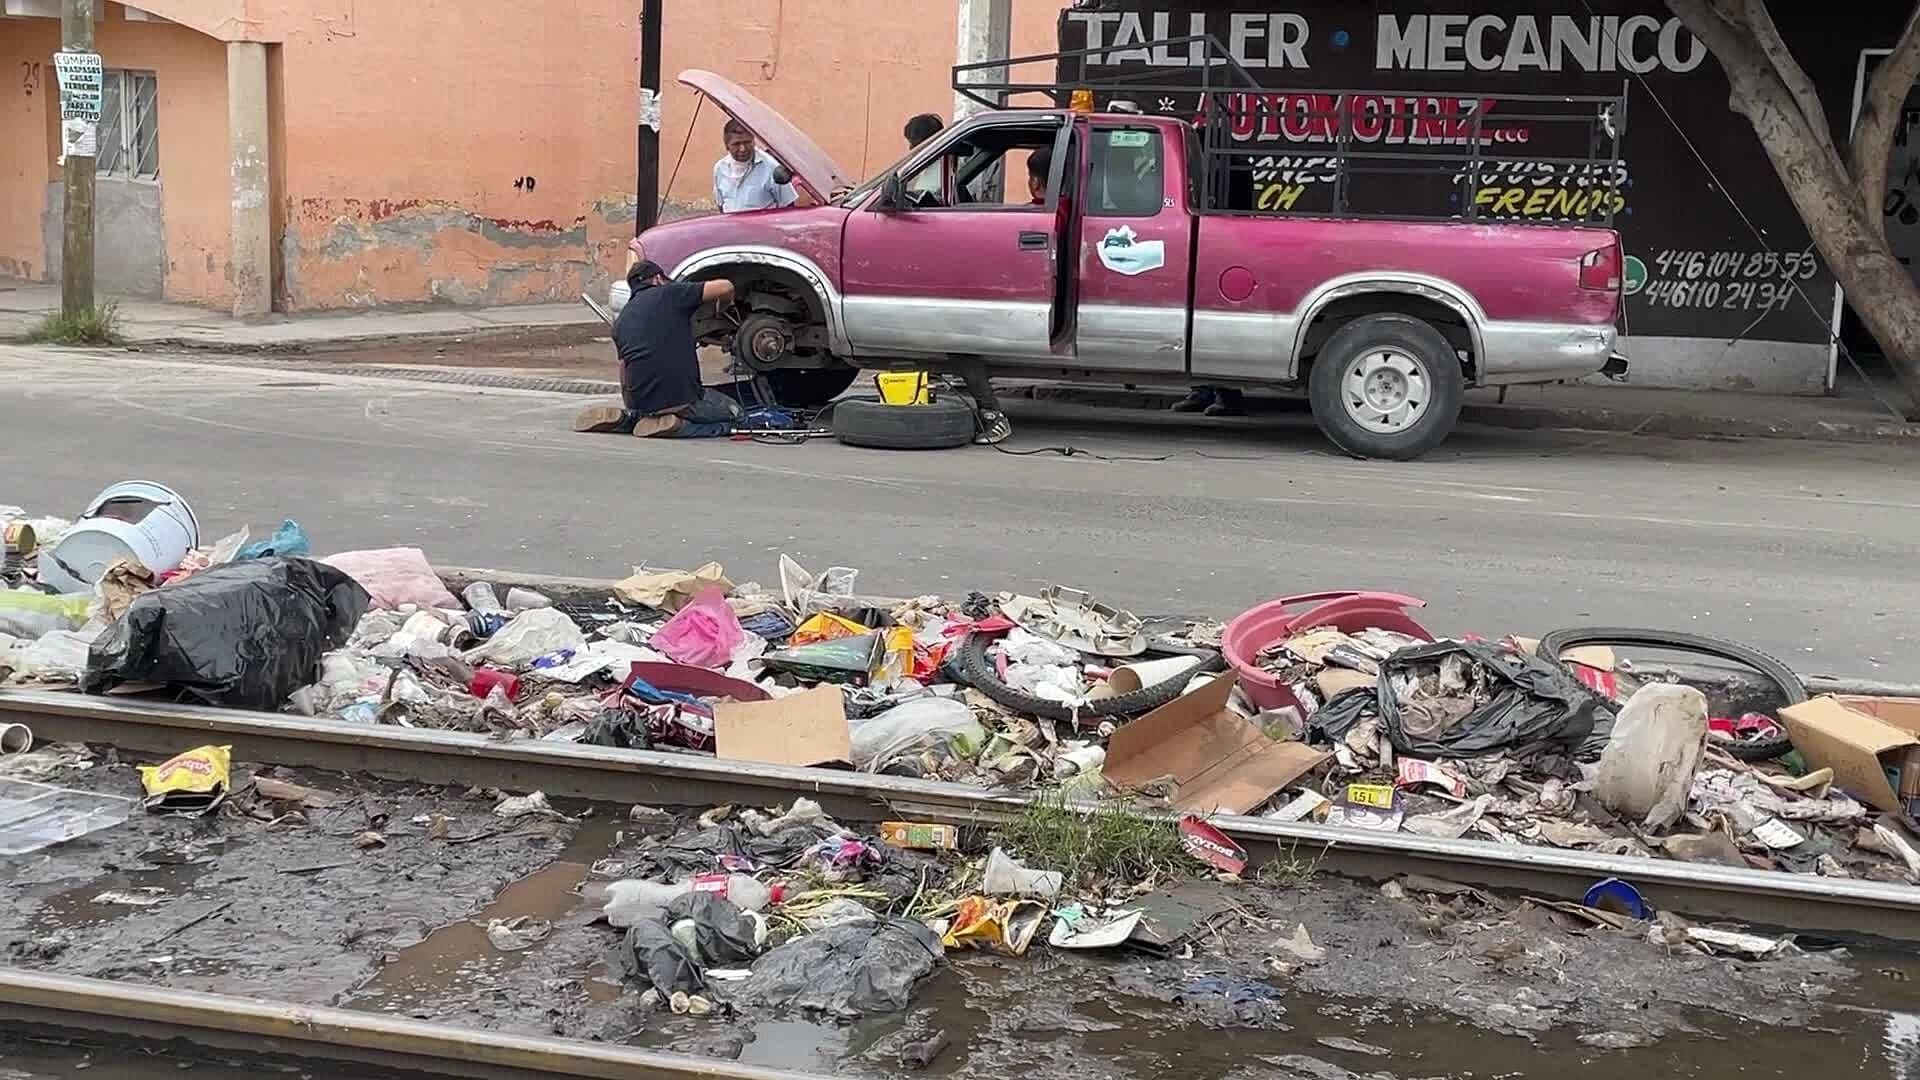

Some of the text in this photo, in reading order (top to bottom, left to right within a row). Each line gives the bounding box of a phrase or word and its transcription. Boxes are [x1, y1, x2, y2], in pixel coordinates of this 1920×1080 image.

[1068, 12, 1707, 73] TALLER MECANICO
[1474, 187, 1627, 216] FRENOS
